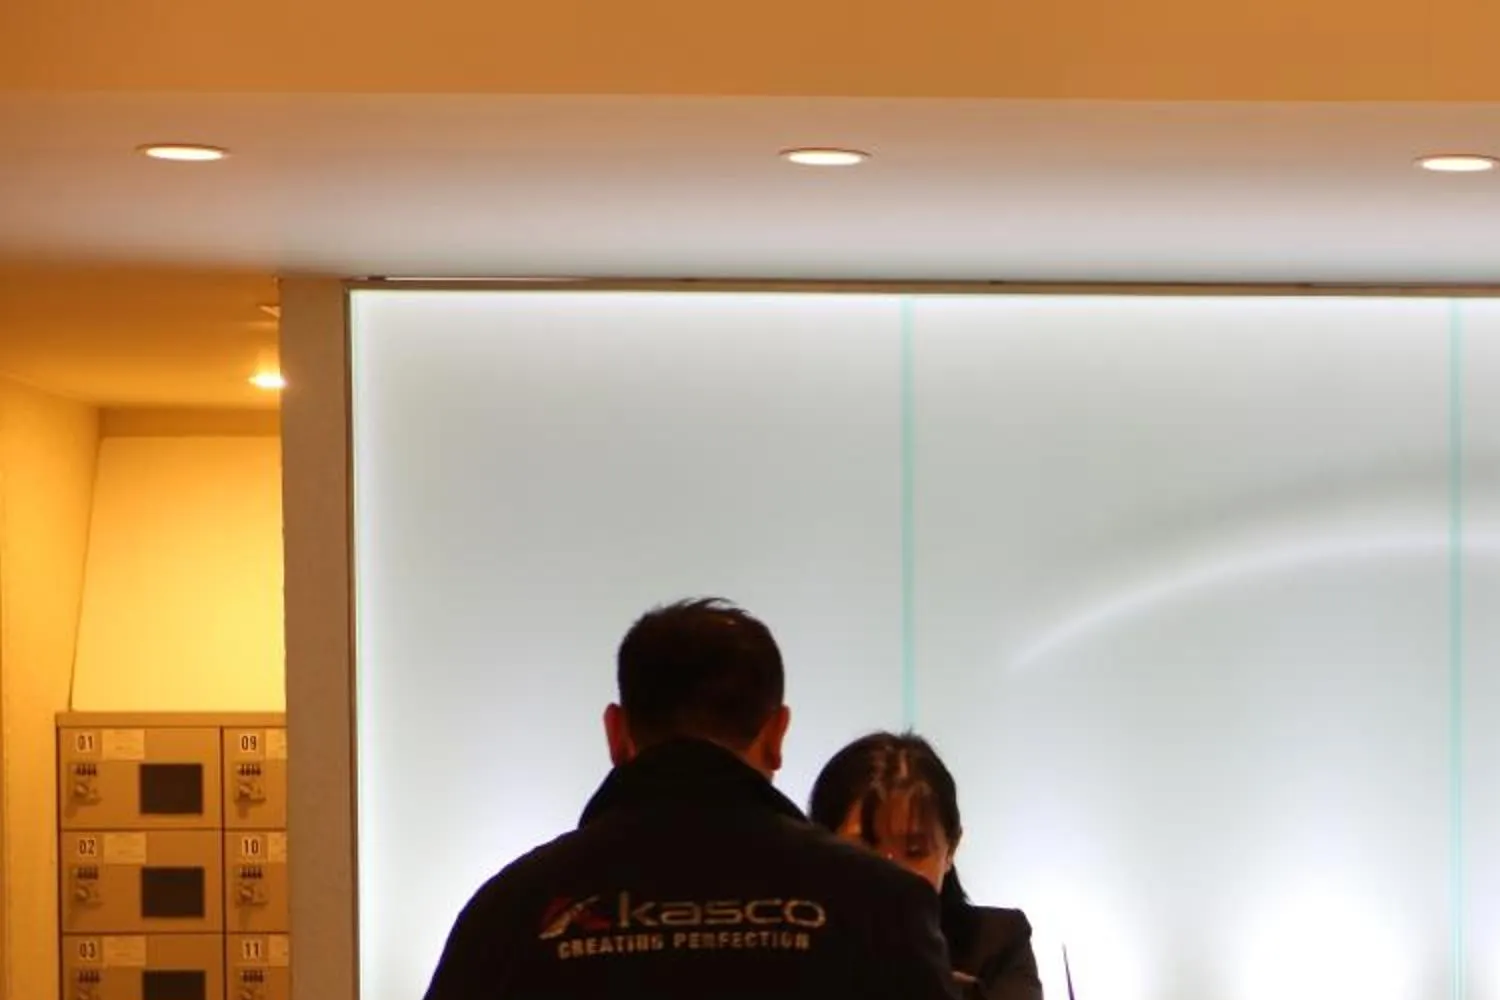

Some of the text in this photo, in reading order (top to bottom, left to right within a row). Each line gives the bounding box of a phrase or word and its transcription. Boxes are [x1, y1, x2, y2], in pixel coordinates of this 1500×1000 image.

[77, 735, 94, 751] 01
[241, 735, 258, 751] 09
[79, 839, 96, 855] 02
[243, 839, 260, 855] 10
[618, 890, 827, 929] kasco
[79, 943, 97, 959] 03
[244, 943, 260, 958] 11
[557, 930, 810, 960] CREATING PERFECTION
